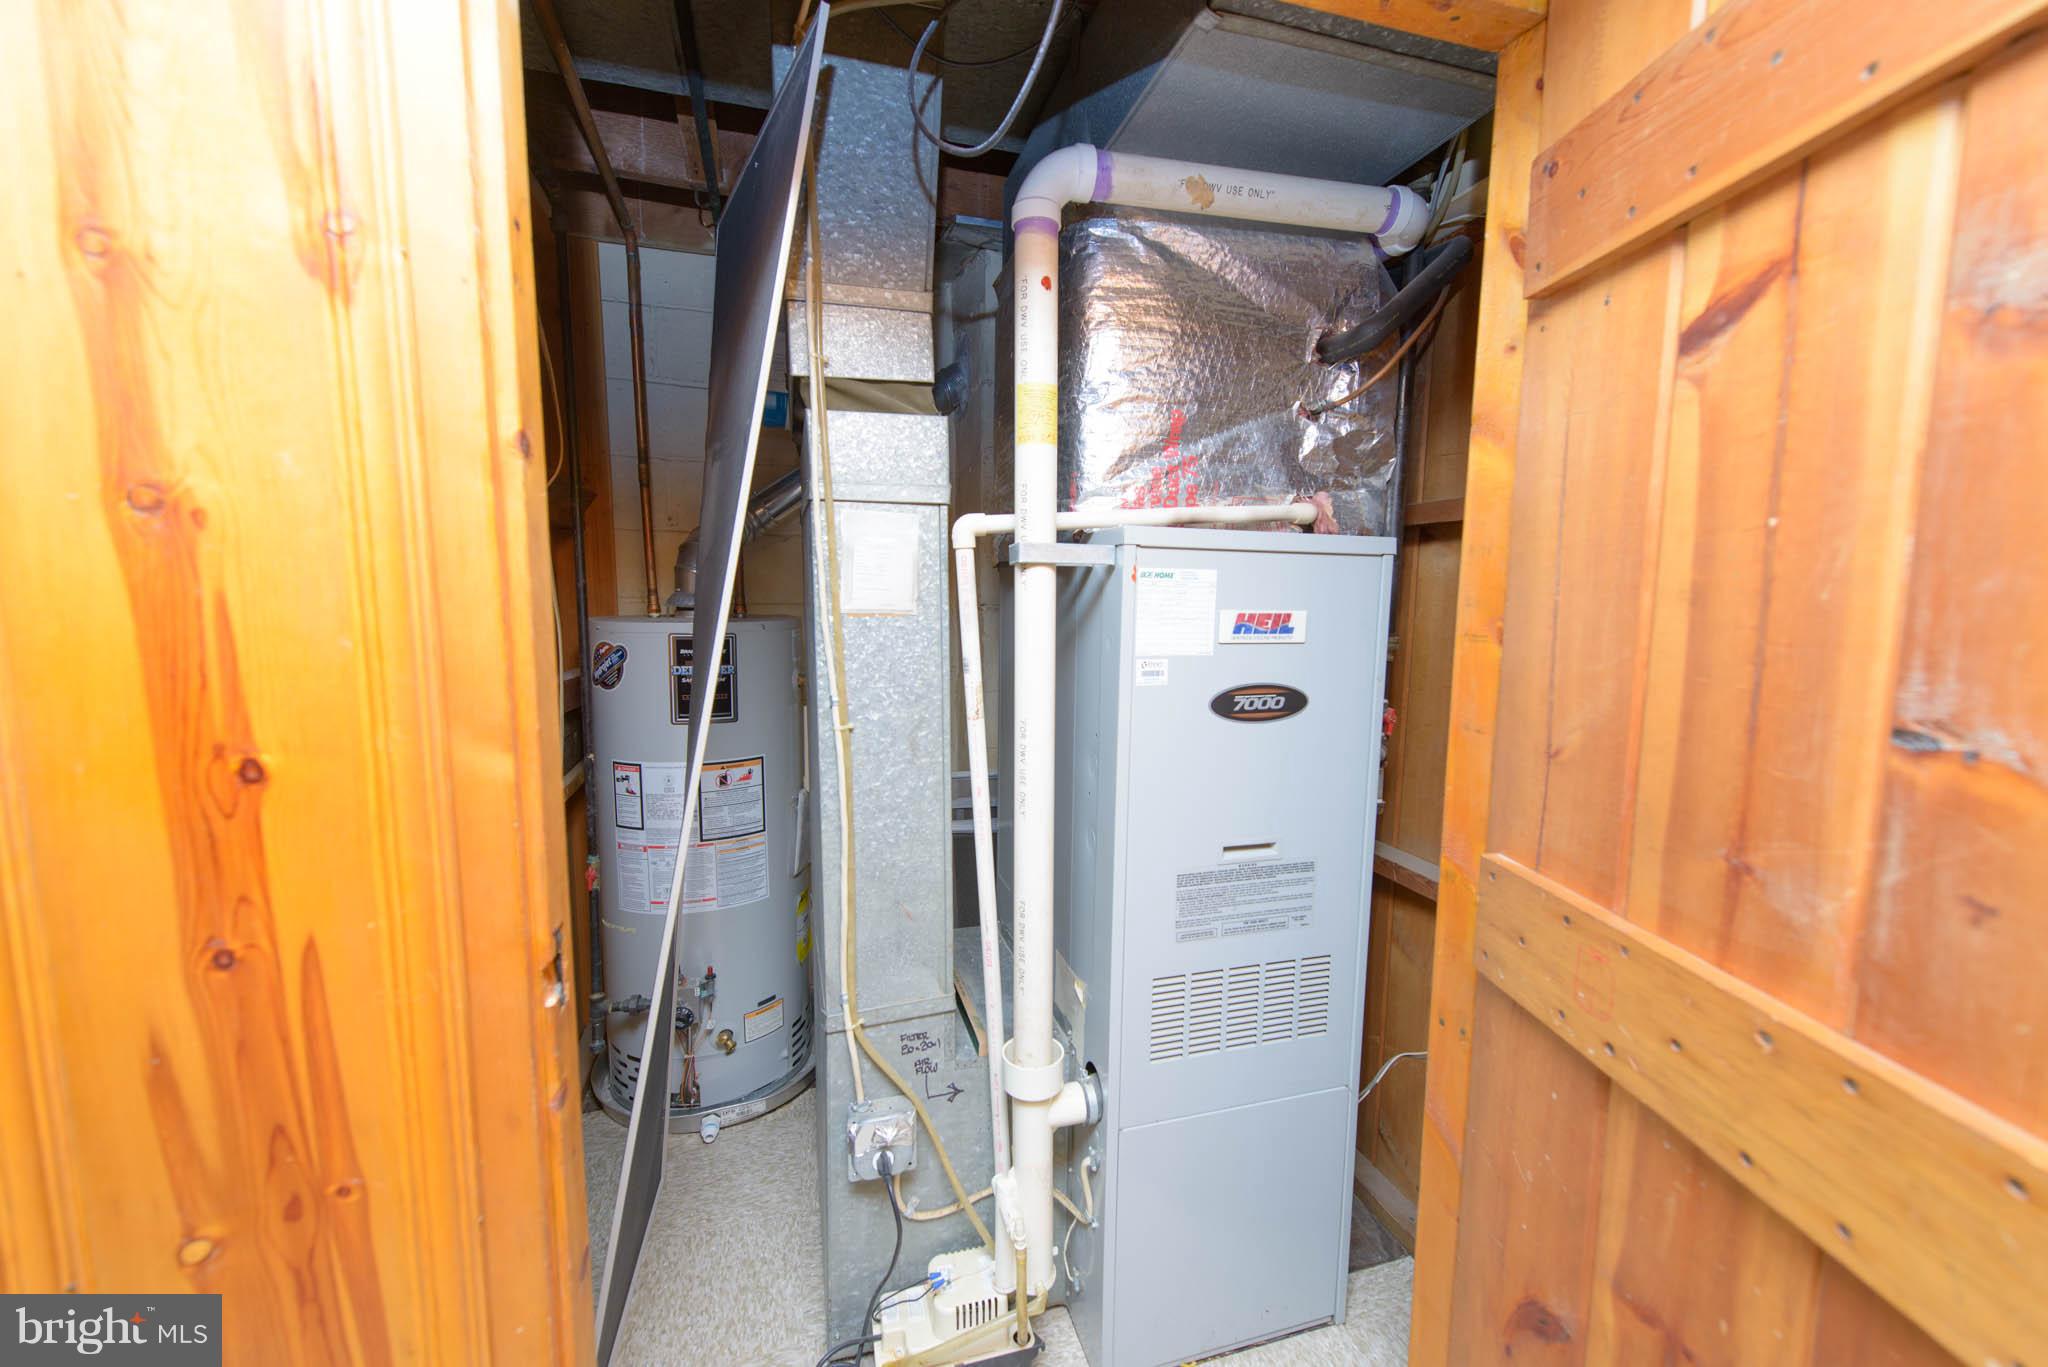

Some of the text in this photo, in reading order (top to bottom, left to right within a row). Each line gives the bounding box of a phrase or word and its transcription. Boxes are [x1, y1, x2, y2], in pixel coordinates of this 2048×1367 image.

[1226, 185, 1245, 197] USE
[1232, 613, 1294, 634] HEIL
[1233, 695, 1285, 711] 7000
